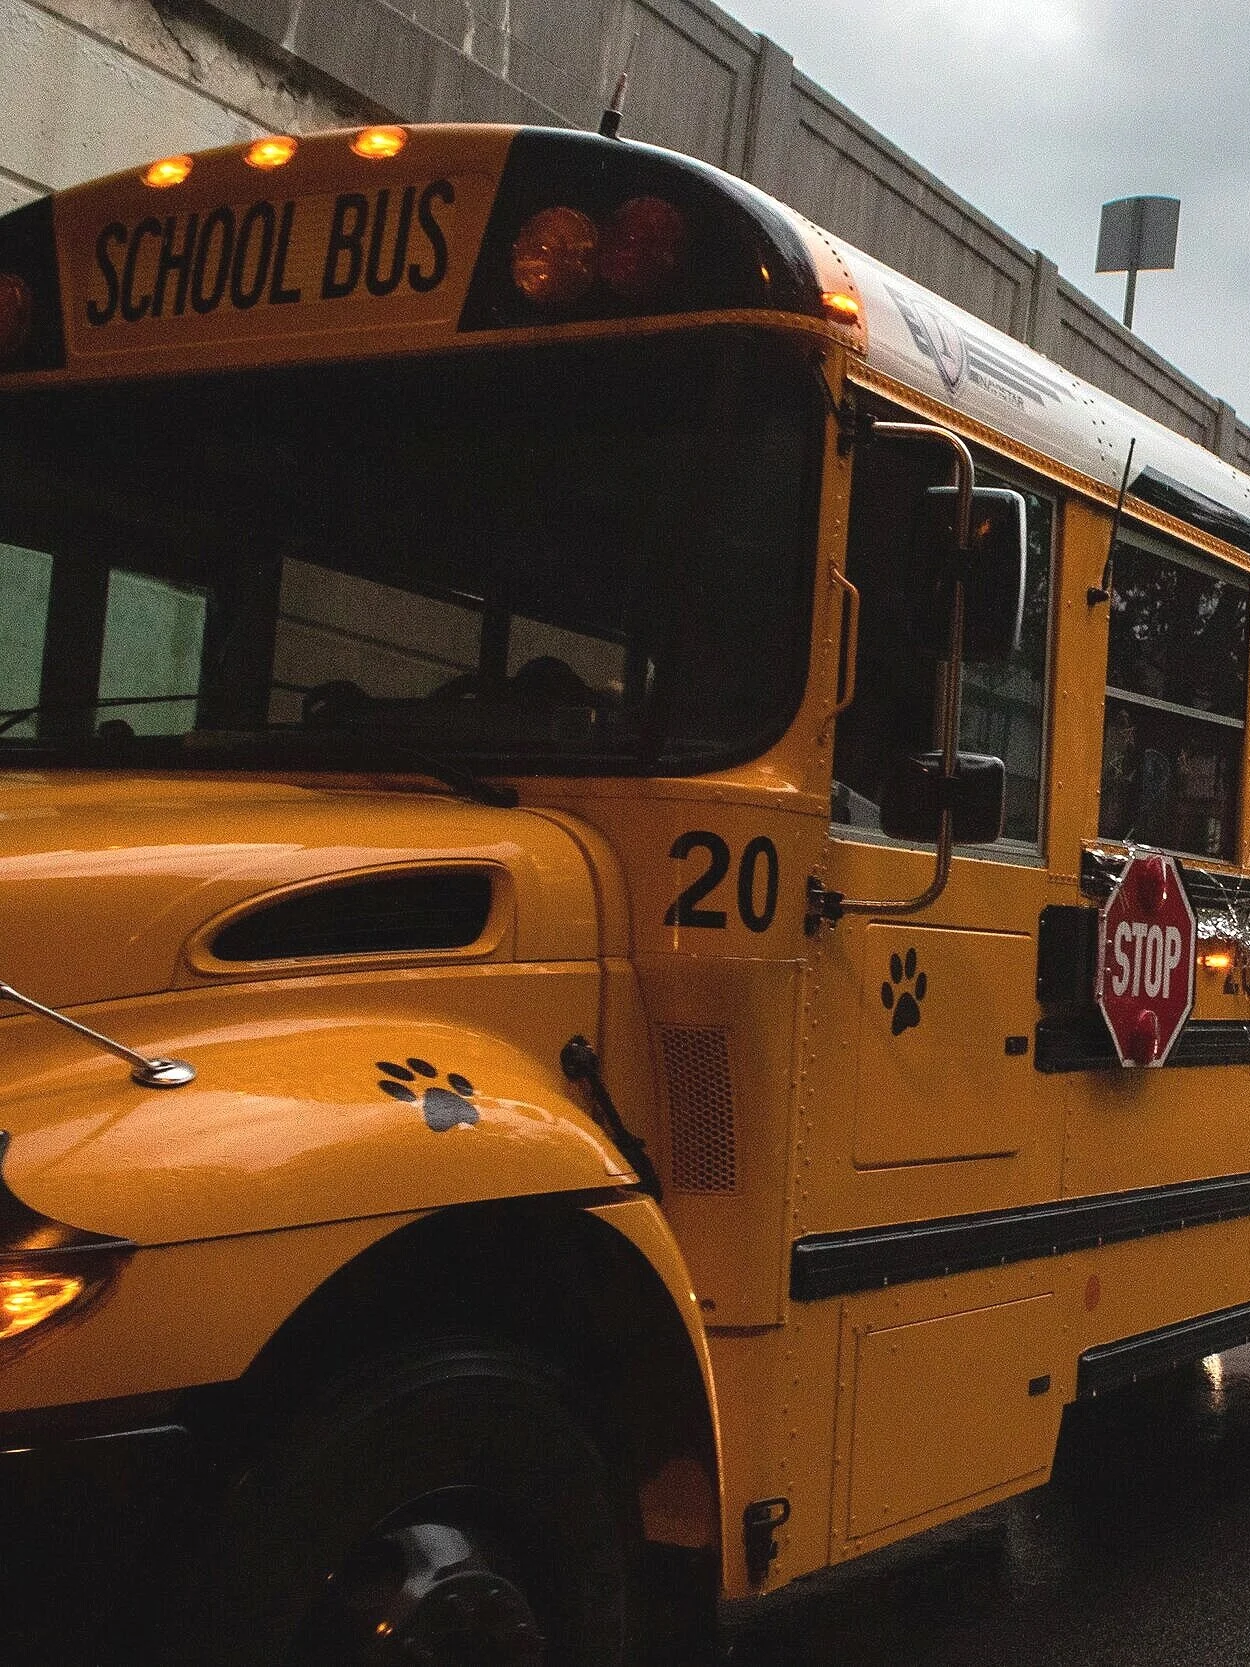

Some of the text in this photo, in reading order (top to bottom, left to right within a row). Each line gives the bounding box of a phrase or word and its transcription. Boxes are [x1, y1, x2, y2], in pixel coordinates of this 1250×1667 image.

[88, 179, 456, 326] SCHOOL BUS
[664, 830, 779, 933] 20
[1112, 920, 1181, 999] STOP
